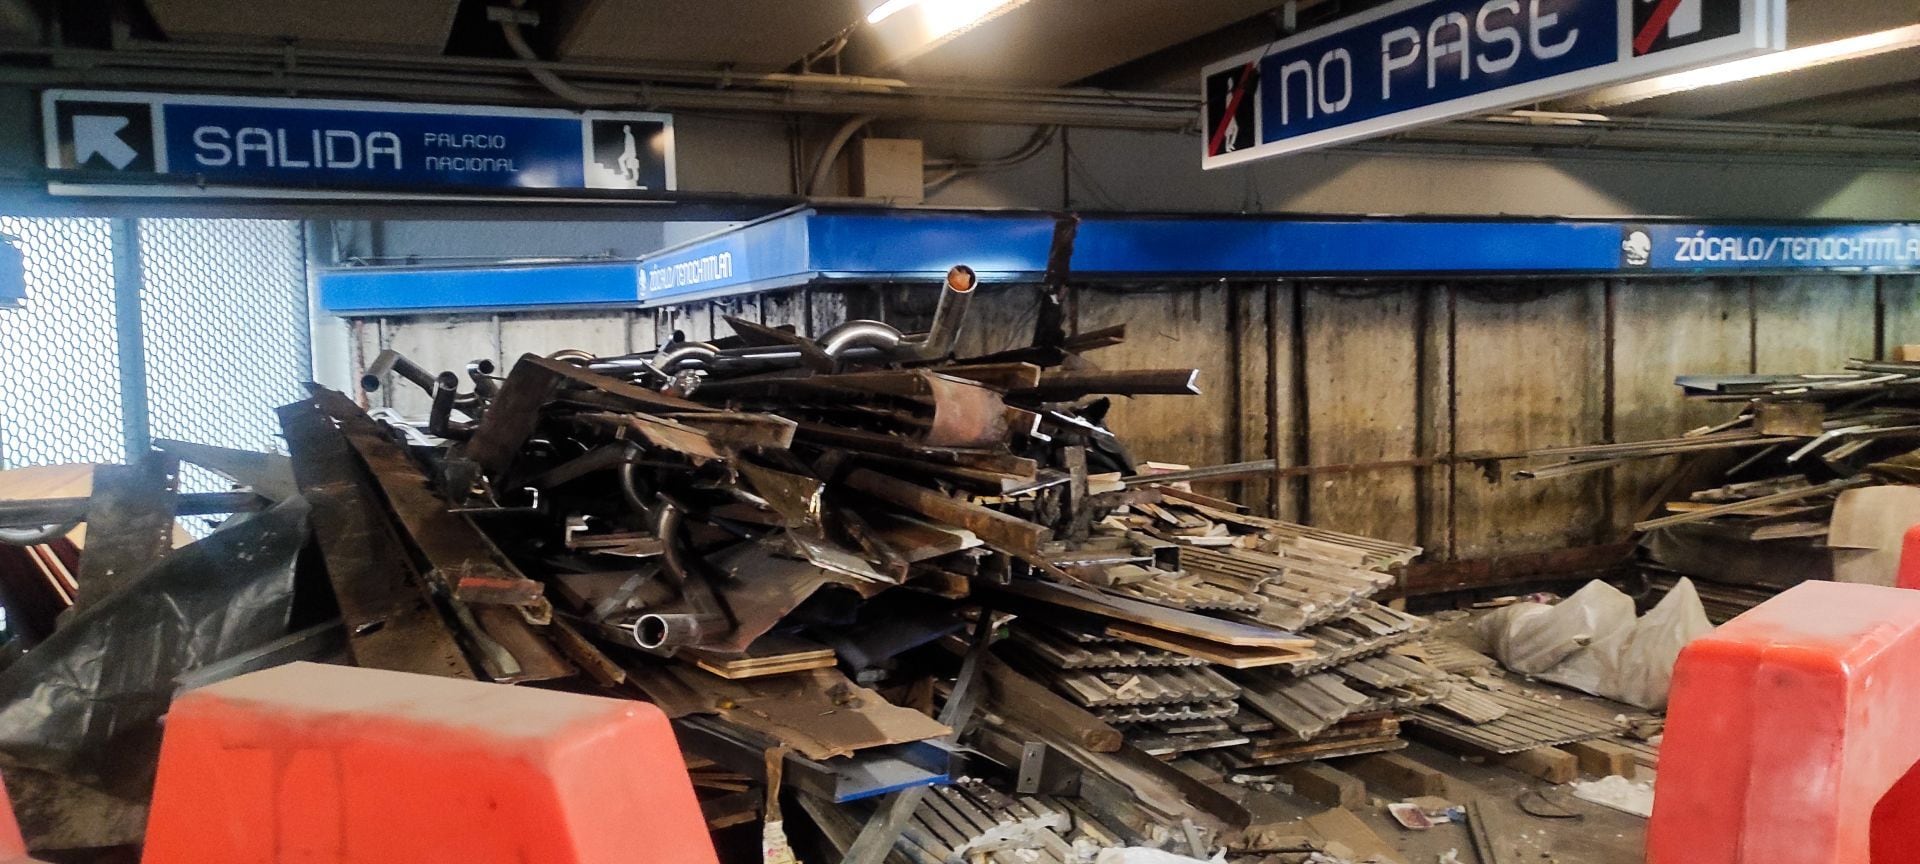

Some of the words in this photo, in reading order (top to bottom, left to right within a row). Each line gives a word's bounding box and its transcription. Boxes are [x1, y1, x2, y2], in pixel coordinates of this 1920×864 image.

[1281, 47, 1353, 126] NO
[1381, 0, 1580, 100] PASE
[192, 125, 403, 170] SALIDA
[423, 132, 506, 149] PALACIO
[425, 156, 520, 172] NACIONAL
[1674, 229, 1920, 261] ZÓCALO/TENOCHTITLA
